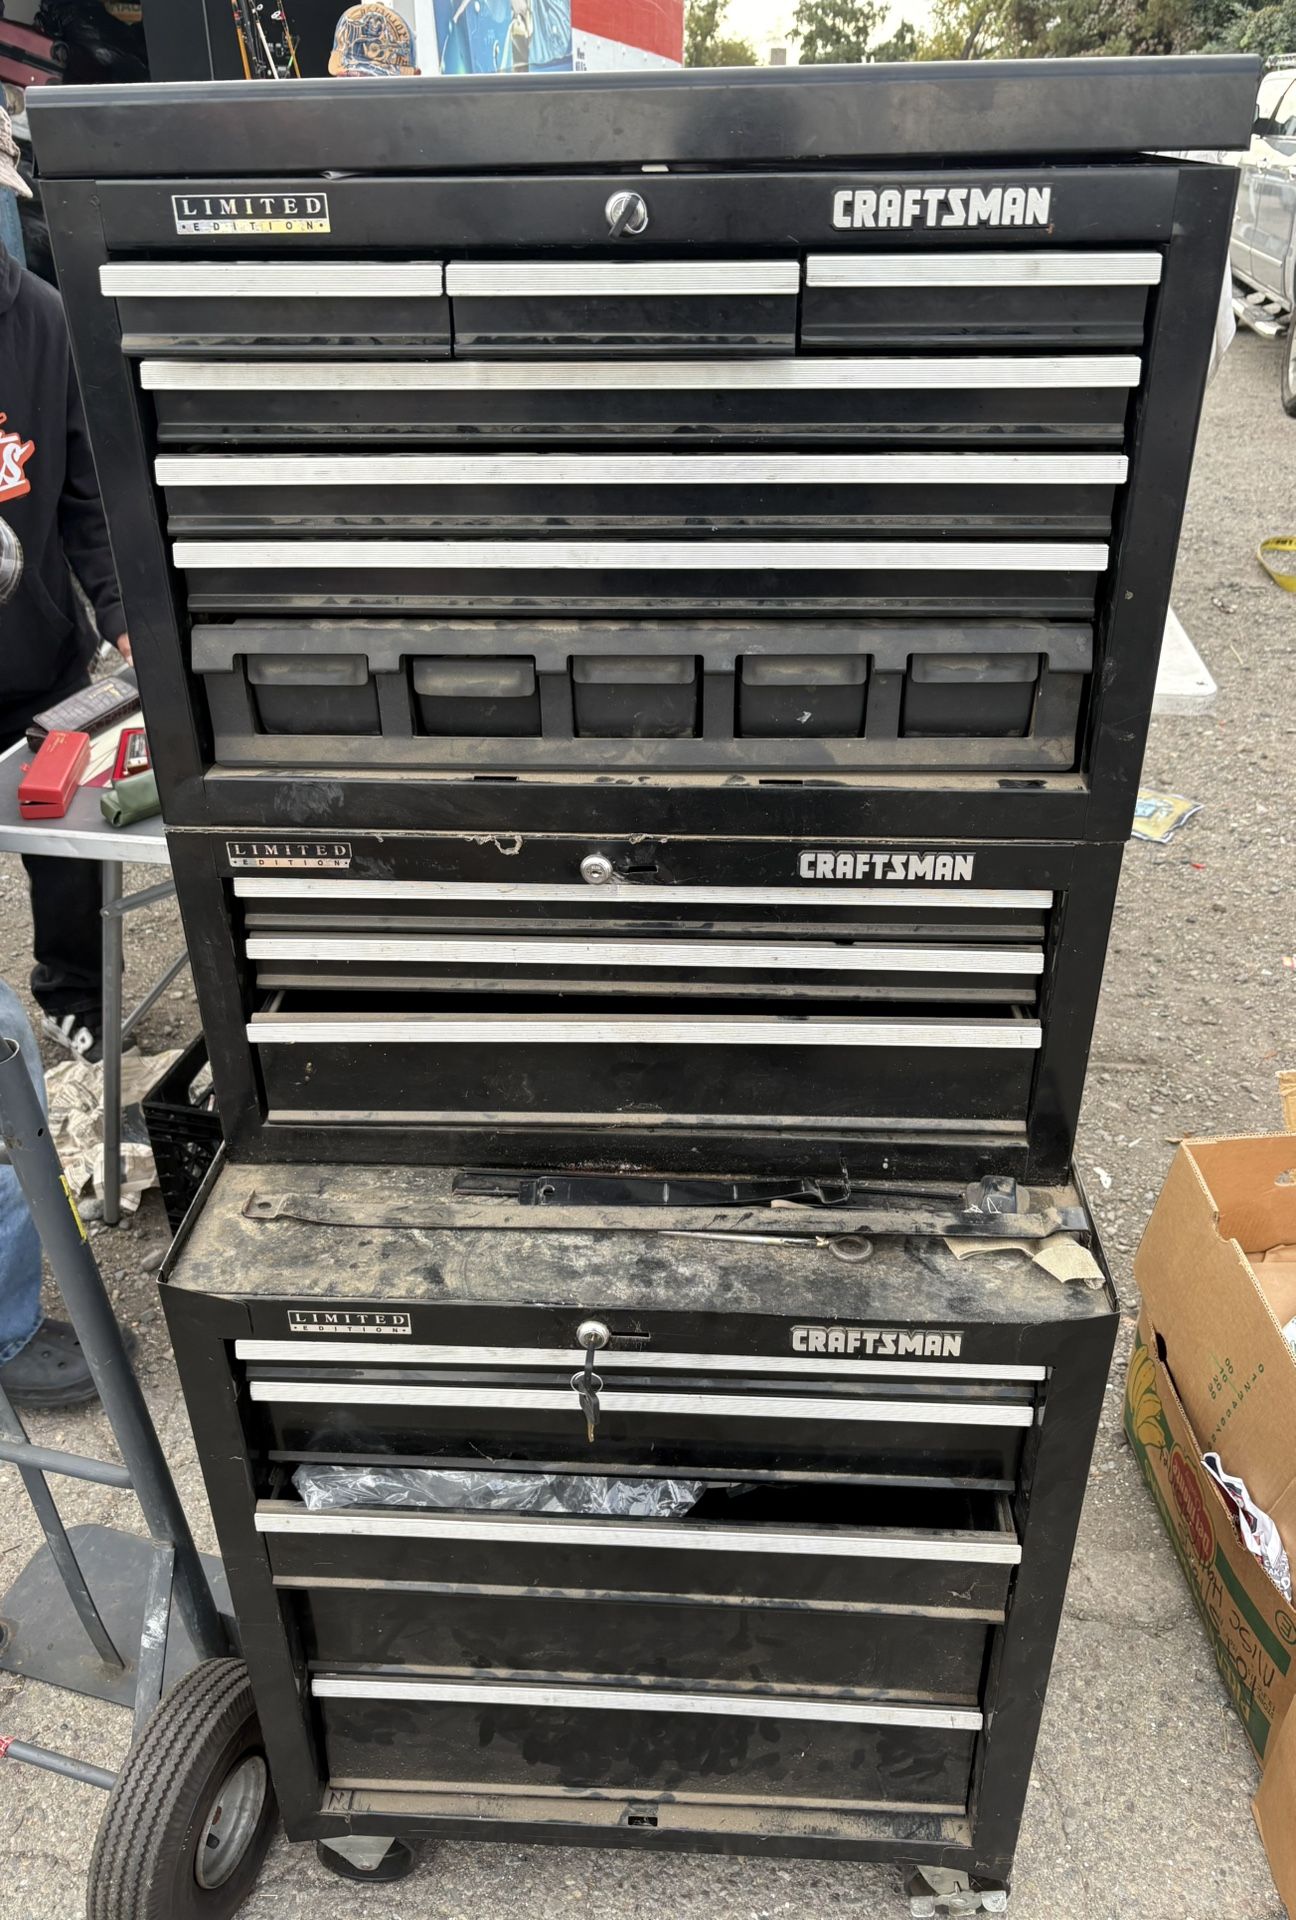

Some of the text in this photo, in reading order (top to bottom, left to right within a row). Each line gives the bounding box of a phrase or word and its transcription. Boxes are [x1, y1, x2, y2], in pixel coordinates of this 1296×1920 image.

[182, 197, 321, 216] LIMITED
[832, 187, 1052, 229] CRAFTSMAN
[194, 220, 314, 232] EDITION
[234, 844, 347, 856] LIMITED
[243, 858, 341, 867] EDITION
[799, 852, 975, 881] CRAFTSMAN
[295, 1313, 406, 1325] LIMITED
[791, 1327, 963, 1357] CRAFTSMAN
